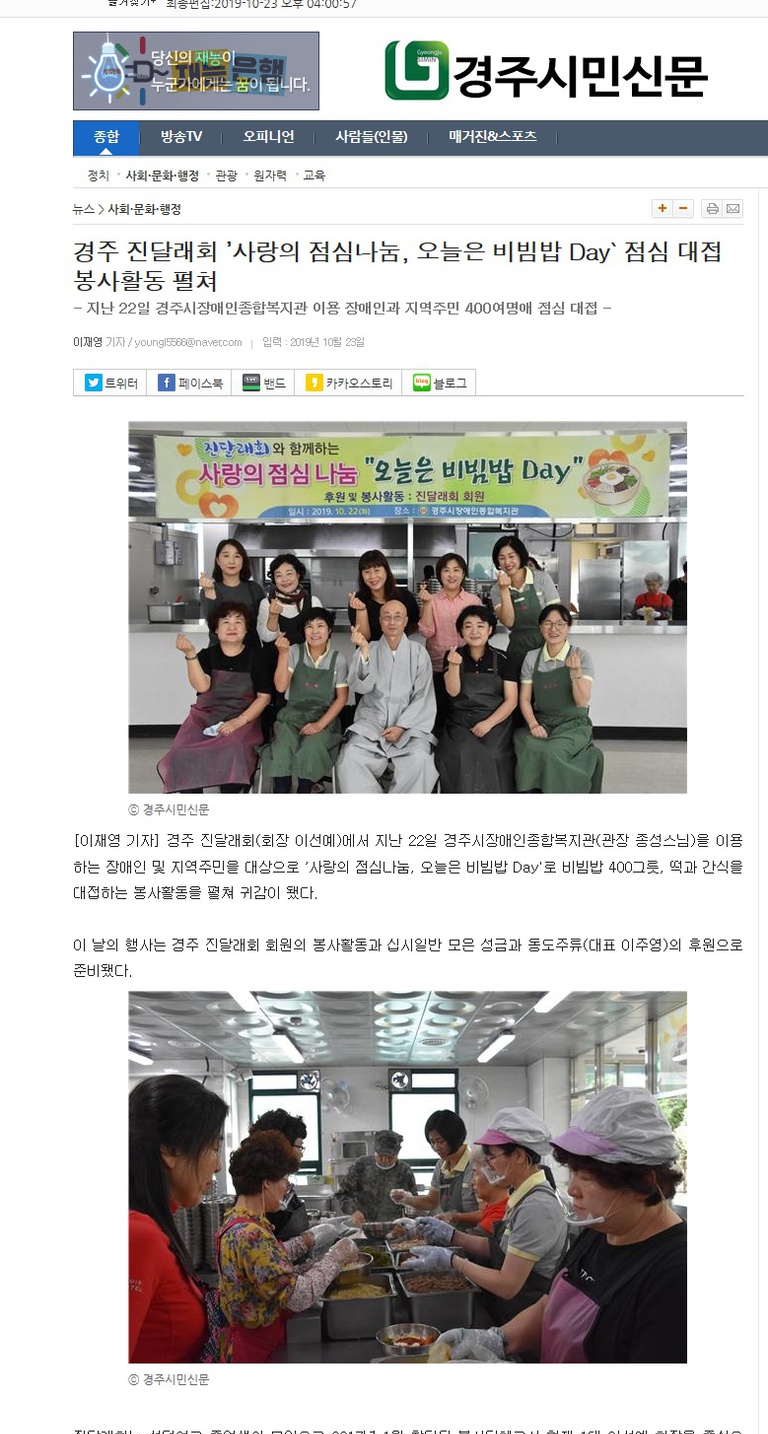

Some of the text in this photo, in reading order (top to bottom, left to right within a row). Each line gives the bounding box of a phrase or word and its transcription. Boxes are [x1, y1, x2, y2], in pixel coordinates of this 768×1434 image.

[152, 50, 236, 66] 당신의 재능이
[453, 55, 708, 98] 경주시민신문
[151, 76, 311, 93] 누군가에게는 꿈이 됩니다.
[94, 130, 120, 143] 종합
[162, 130, 202, 143] 방송TV
[243, 130, 294, 143] 오피니언
[336, 130, 407, 143] 사람들(인물)
[450, 130, 537, 143] 매거진&스포츠
[88, 170, 109, 182] 정치
[216, 170, 238, 182] 관광
[254, 170, 287, 182] 원자력
[304, 170, 326, 182] 교육
[73, 204, 95, 215] 뉴스
[74, 241, 119, 262] 경주
[128, 241, 216, 262] 진달래회
[310, 241, 407, 264] 점심나눔,
[417, 241, 485, 262] 오늘은
[494, 241, 562, 262] 비빔밥
[625, 241, 667, 262] 점심
[679, 241, 720, 262] 대접
[74, 270, 215, 292] 봉사활동 펼쳐
[87, 301, 597, 315] 지난 22일 경주시장애인종합복지관 이용 장애인과 지역주민 400여명애 점심 대접
[74, 337, 102, 347] 이재영
[106, 337, 125, 347] 기자
[263, 337, 281, 347] 입력
[291, 337, 319, 347] 2019년
[323, 337, 341, 347] 10월
[346, 337, 364, 347] 23일
[105, 378, 137, 390] 트위터
[179, 378, 223, 389] 페이스북
[264, 378, 286, 390] 밴드
[327, 378, 392, 389] 카카오스토리
[434, 378, 467, 390] 블로그
[290, 442, 340, 456] 함께하는
[199, 456, 583, 485] 사랑의 점심 나눔 "오늘은 비빔밥 Day"
[325, 490, 485, 502] 후원 및 봉사활동 진달래회 회원
[288, 507, 305, 517] 일시
[312, 507, 334, 517] 2019.
[336, 507, 347, 517] 10.
[394, 506, 410, 516] 장소
[144, 804, 209, 816] 경주시민신문
[76, 834, 743, 847] [이재영 기자] 경주 진달래회(회장 이선예)에서 지난 22일 경주시장애인종합복지관(관장 종성스님)을 이용
[74, 886, 317, 899] 대접하는 봉사활동을 펼쳐 귀감이 됐다.
[74, 964, 131, 977] 준비됐다.
[144, 1374, 209, 1385] 경주시민신문
